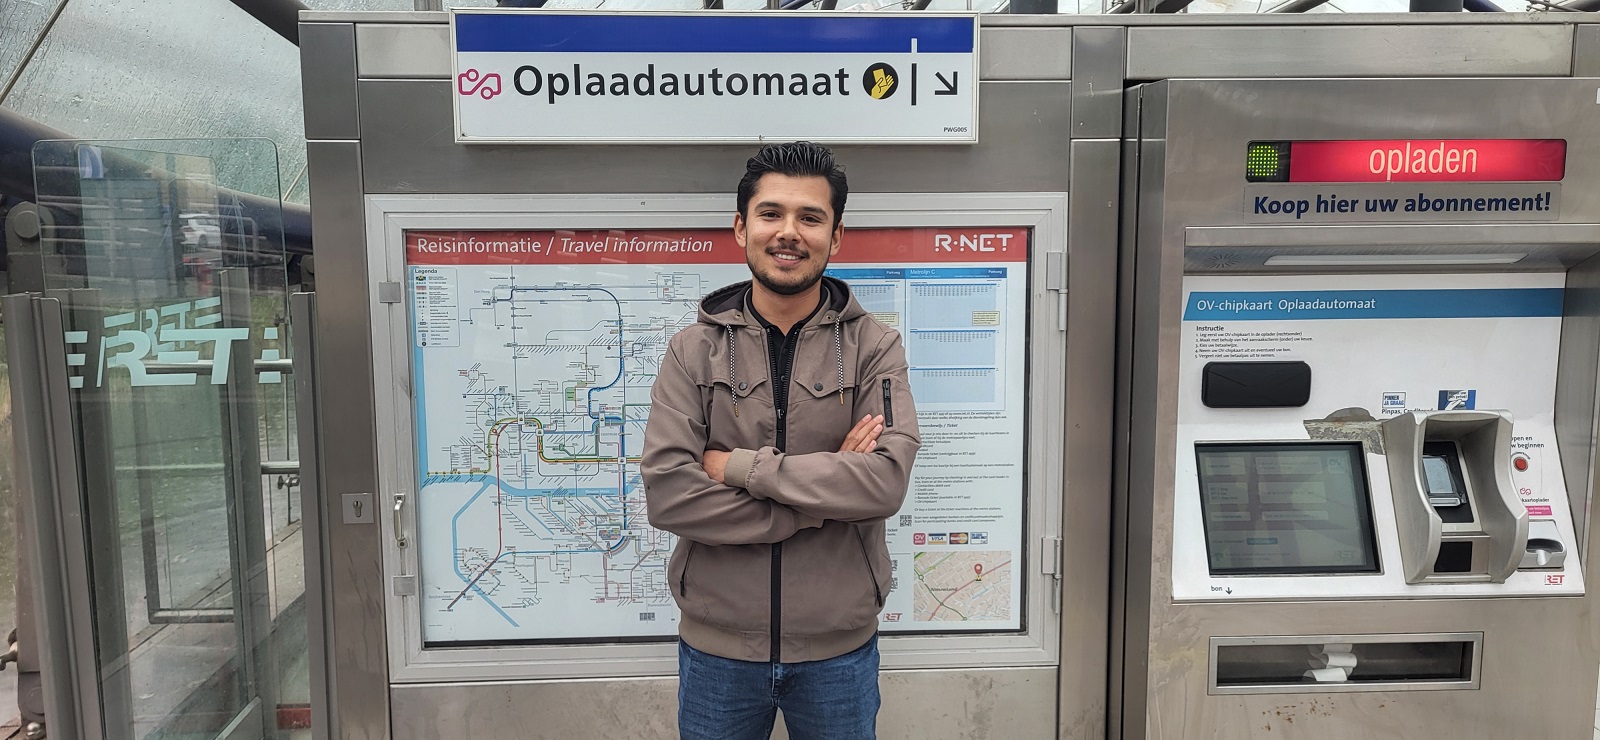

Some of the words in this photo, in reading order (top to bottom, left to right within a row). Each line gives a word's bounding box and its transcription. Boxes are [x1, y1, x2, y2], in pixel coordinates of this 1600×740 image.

[513, 64, 850, 104] Oplaadautomaat
[1368, 142, 1477, 181] opladen
[1253, 195, 1308, 219] Koop
[1315, 194, 1358, 213] hier
[1364, 198, 1398, 213] uw
[1403, 192, 1550, 212] abonnement!
[417, 237, 542, 253] Reisinformatie
[560, 235, 609, 253] Travel
[612, 234, 713, 252] information
[1196, 300, 1273, 314] OV-chipkaart
[1278, 298, 1376, 313] Oplaadautomaat
[116, 327, 250, 387] RET
[1546, 575, 1565, 584] RET
